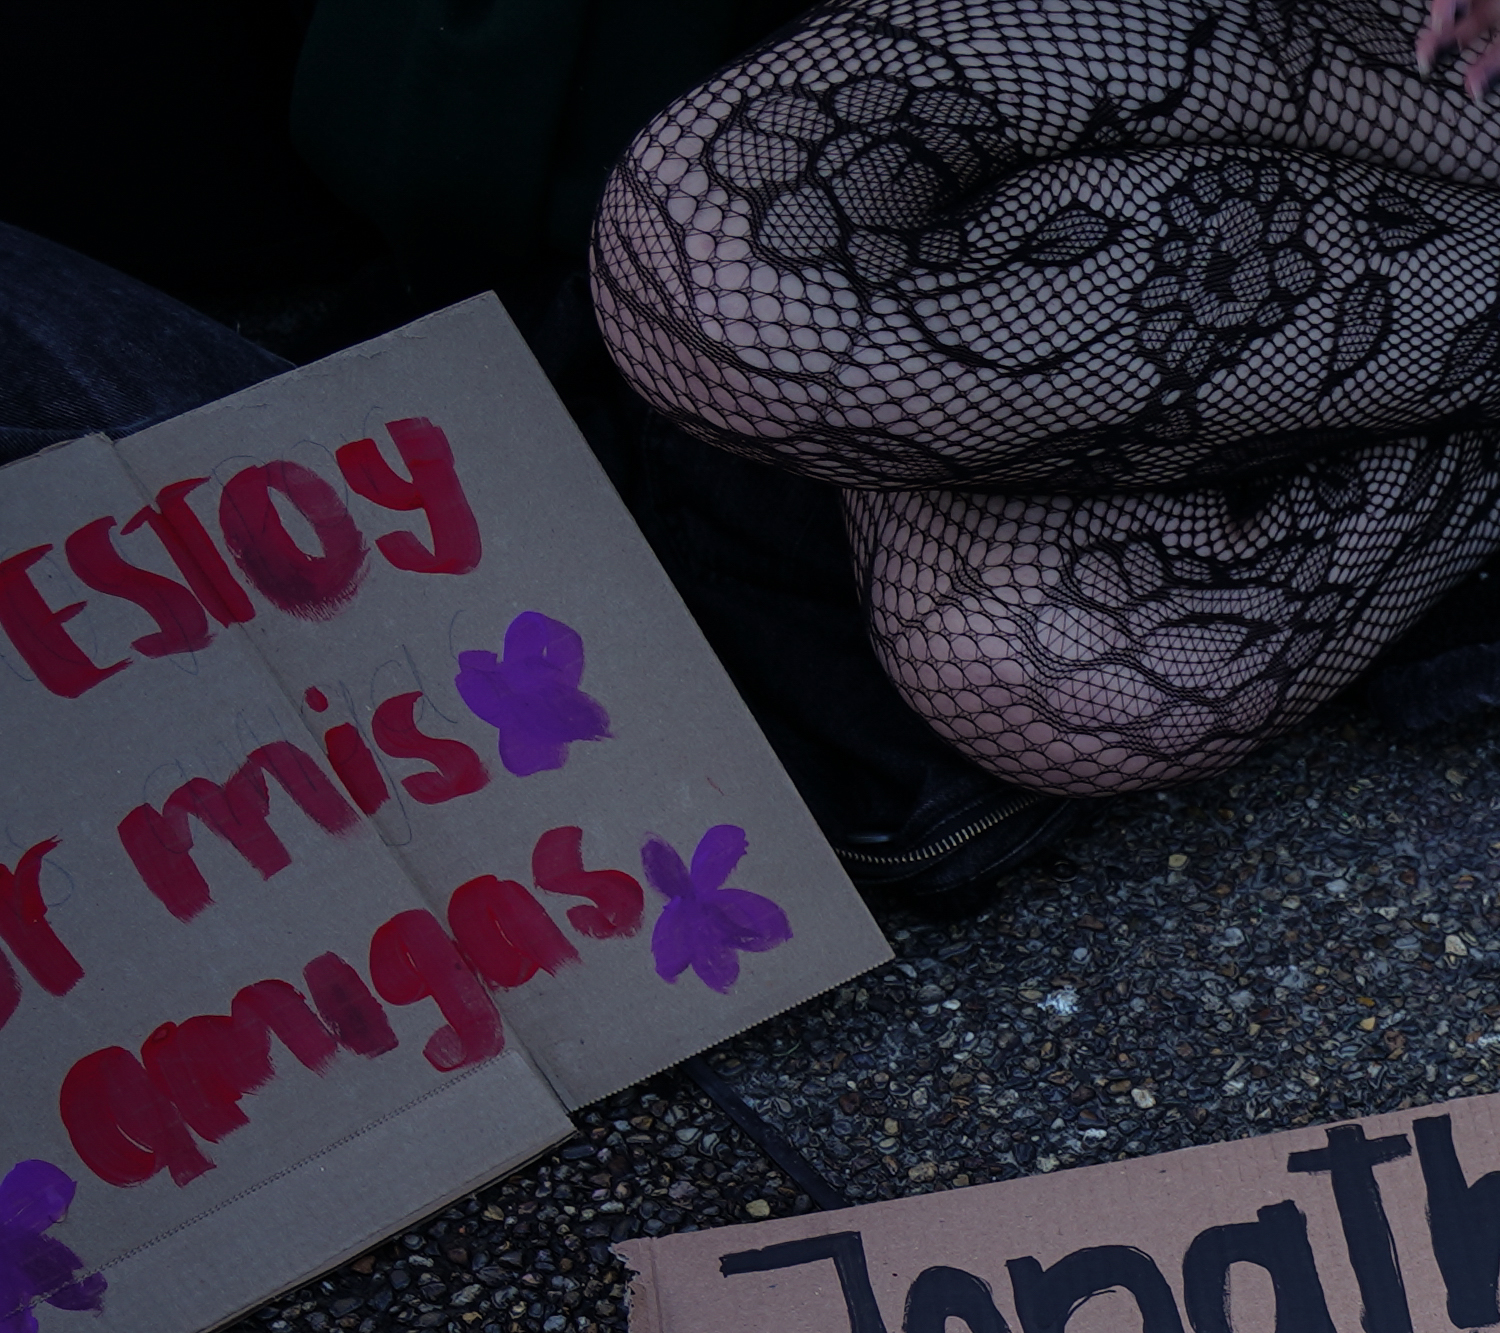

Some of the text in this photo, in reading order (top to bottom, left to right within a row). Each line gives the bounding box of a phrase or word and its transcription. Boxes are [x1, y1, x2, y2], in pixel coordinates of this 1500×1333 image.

[0, 417, 482, 699] ESTOY
[117, 686, 489, 923] mis
[59, 826, 645, 1187] amigas
